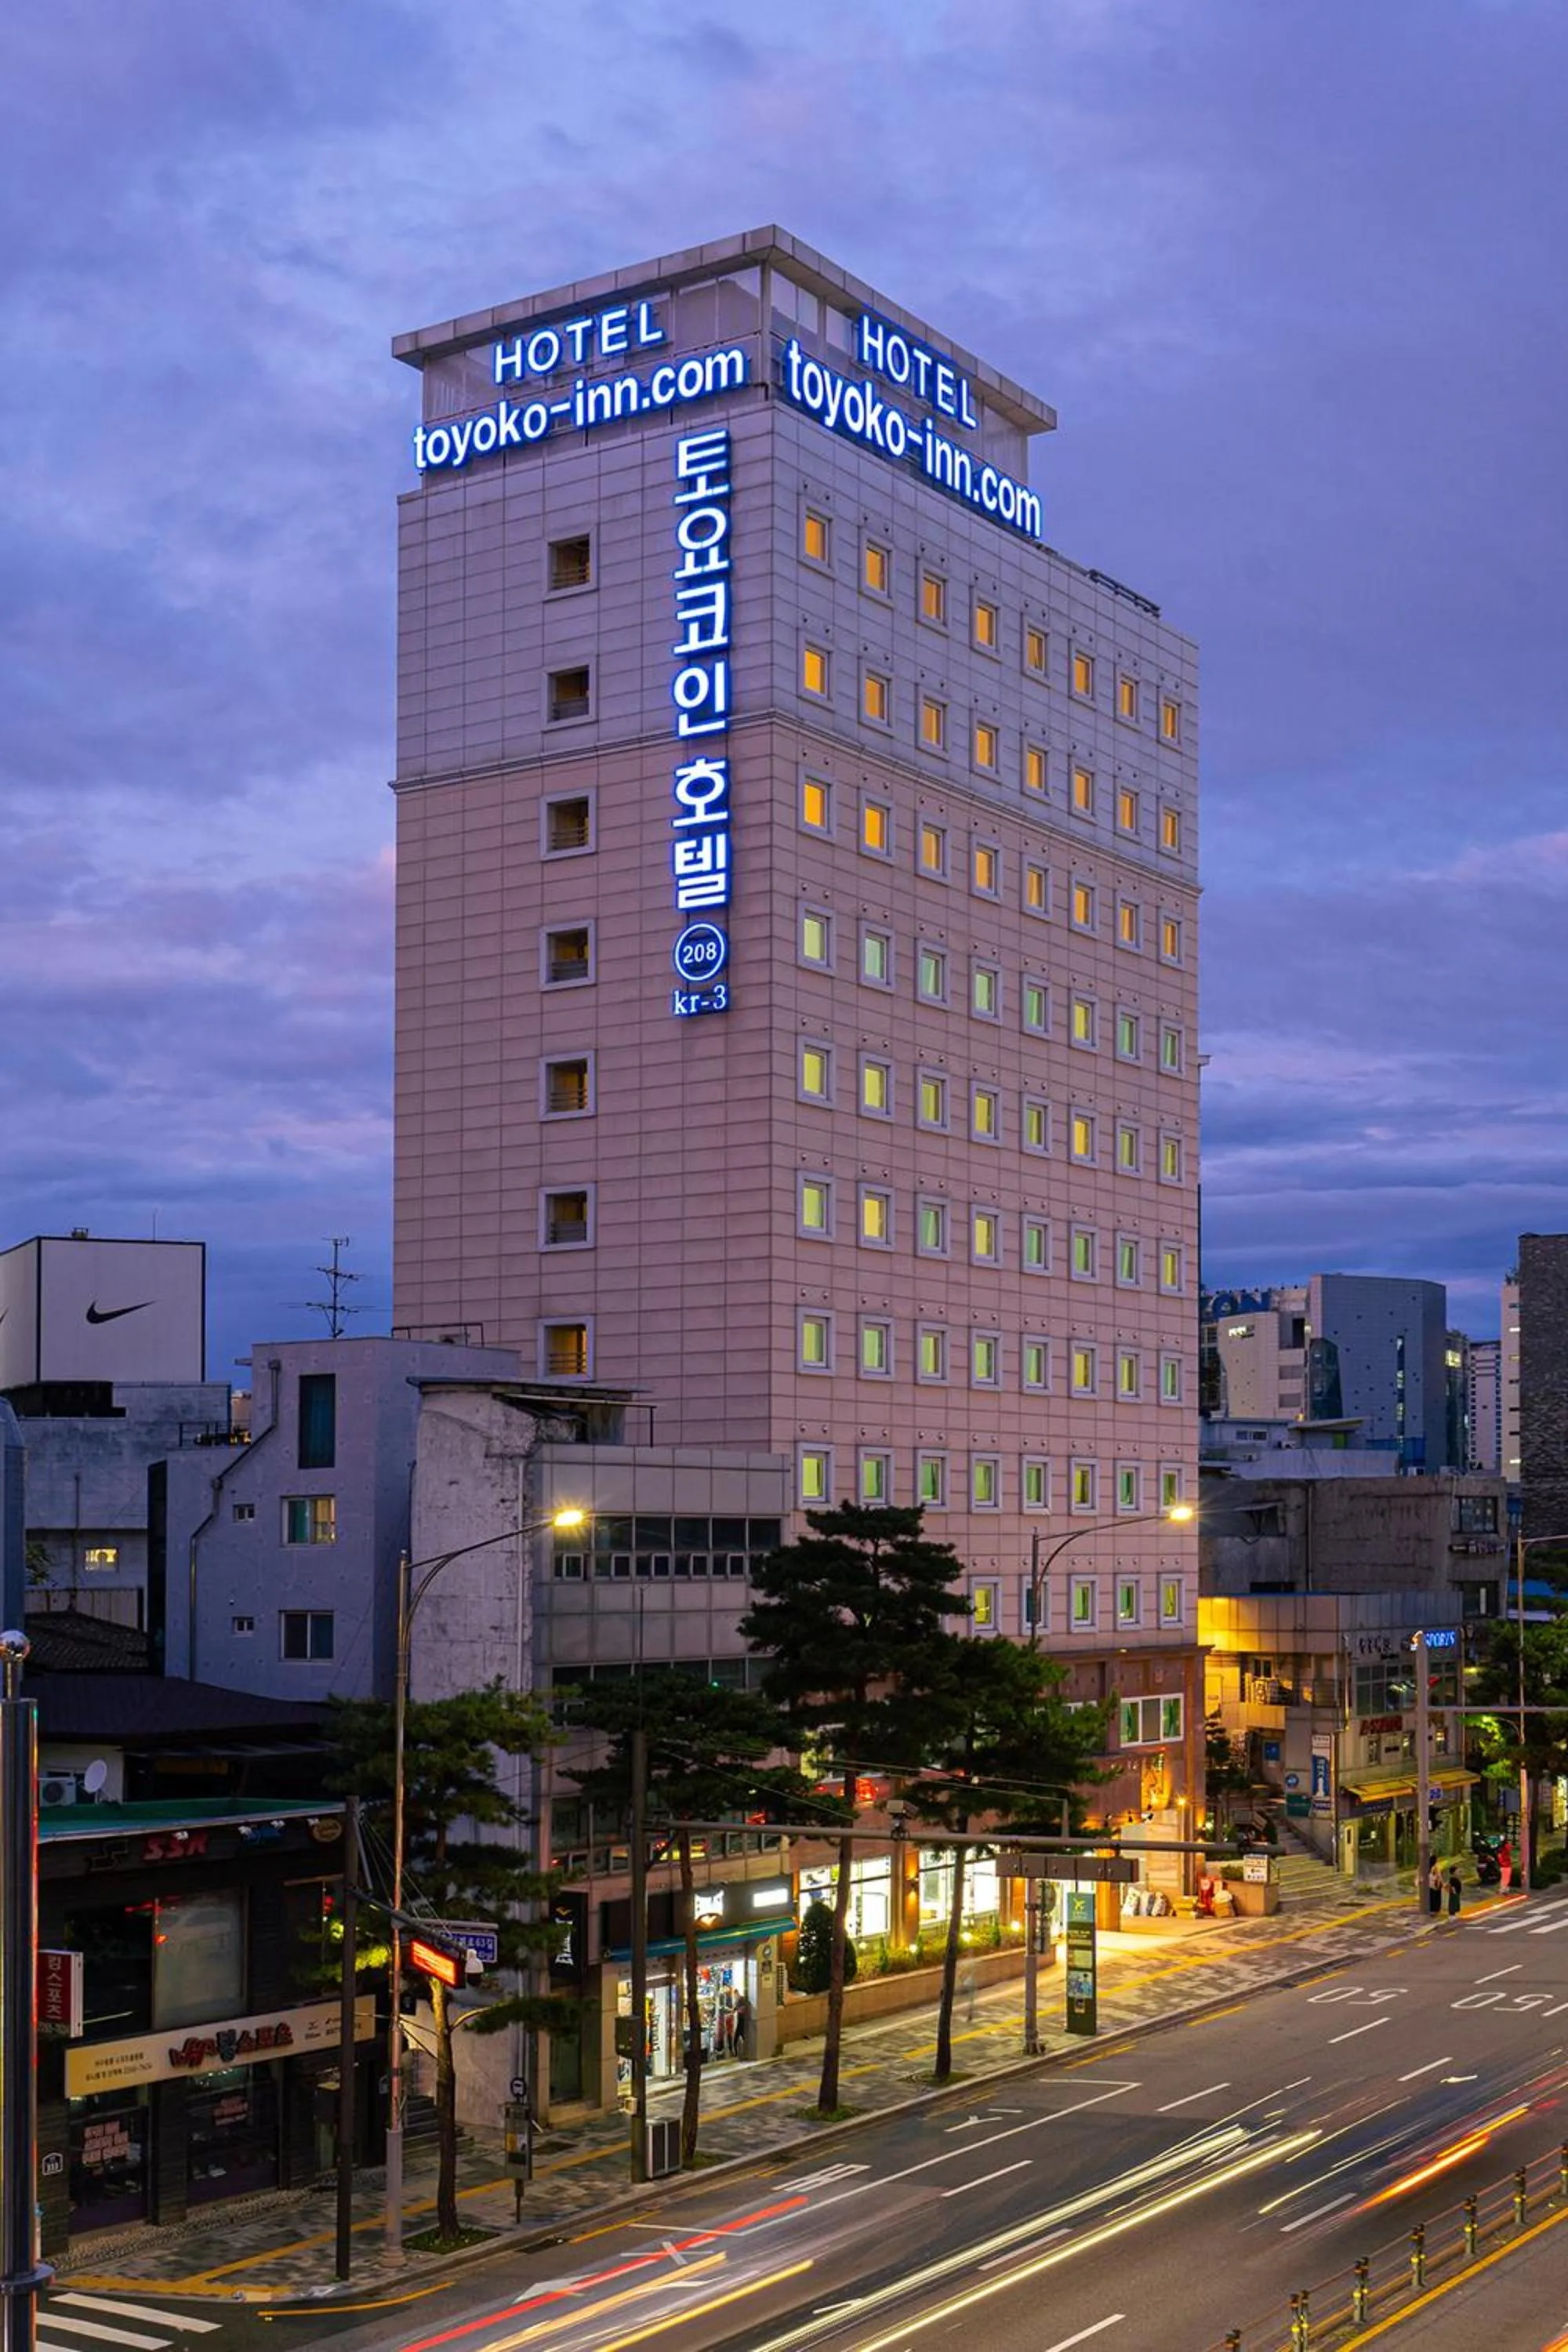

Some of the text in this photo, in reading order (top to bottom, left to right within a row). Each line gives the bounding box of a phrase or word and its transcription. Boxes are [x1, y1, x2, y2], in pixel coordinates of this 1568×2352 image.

[495, 303, 664, 383] HOTEL
[862, 315, 978, 429] HOTEL
[413, 347, 745, 470] toyoko-inn.com
[787, 339, 1041, 539] toyoko-inn.com
[672, 430, 730, 909] 토요코인 호텔
[681, 943, 717, 964] 208
[673, 984, 728, 1015] kr-3
[1306, 1986, 1408, 2005] 50
[1450, 1991, 1554, 2012] 50
